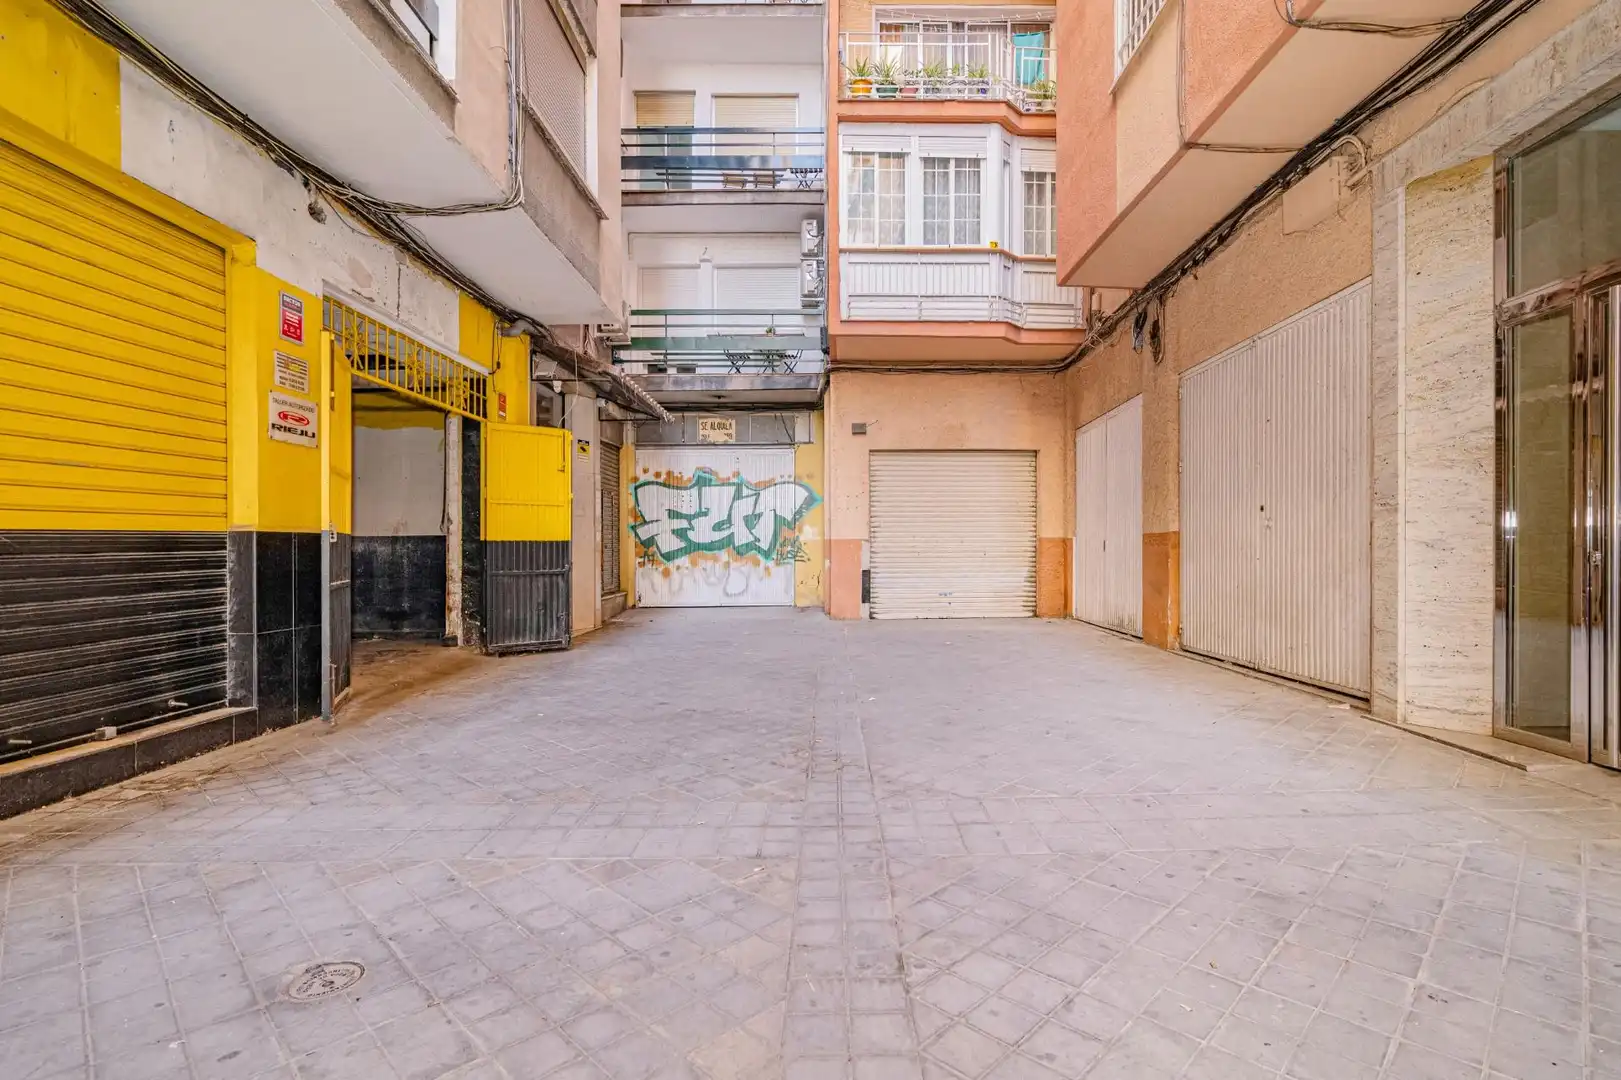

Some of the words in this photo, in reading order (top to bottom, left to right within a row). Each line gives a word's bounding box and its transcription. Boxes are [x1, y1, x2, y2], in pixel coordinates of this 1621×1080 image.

[272, 397, 289, 407] TALLER
[271, 423, 316, 439] RIEJU
[700, 421, 708, 431] SE
[710, 421, 733, 431] ALQUILA
